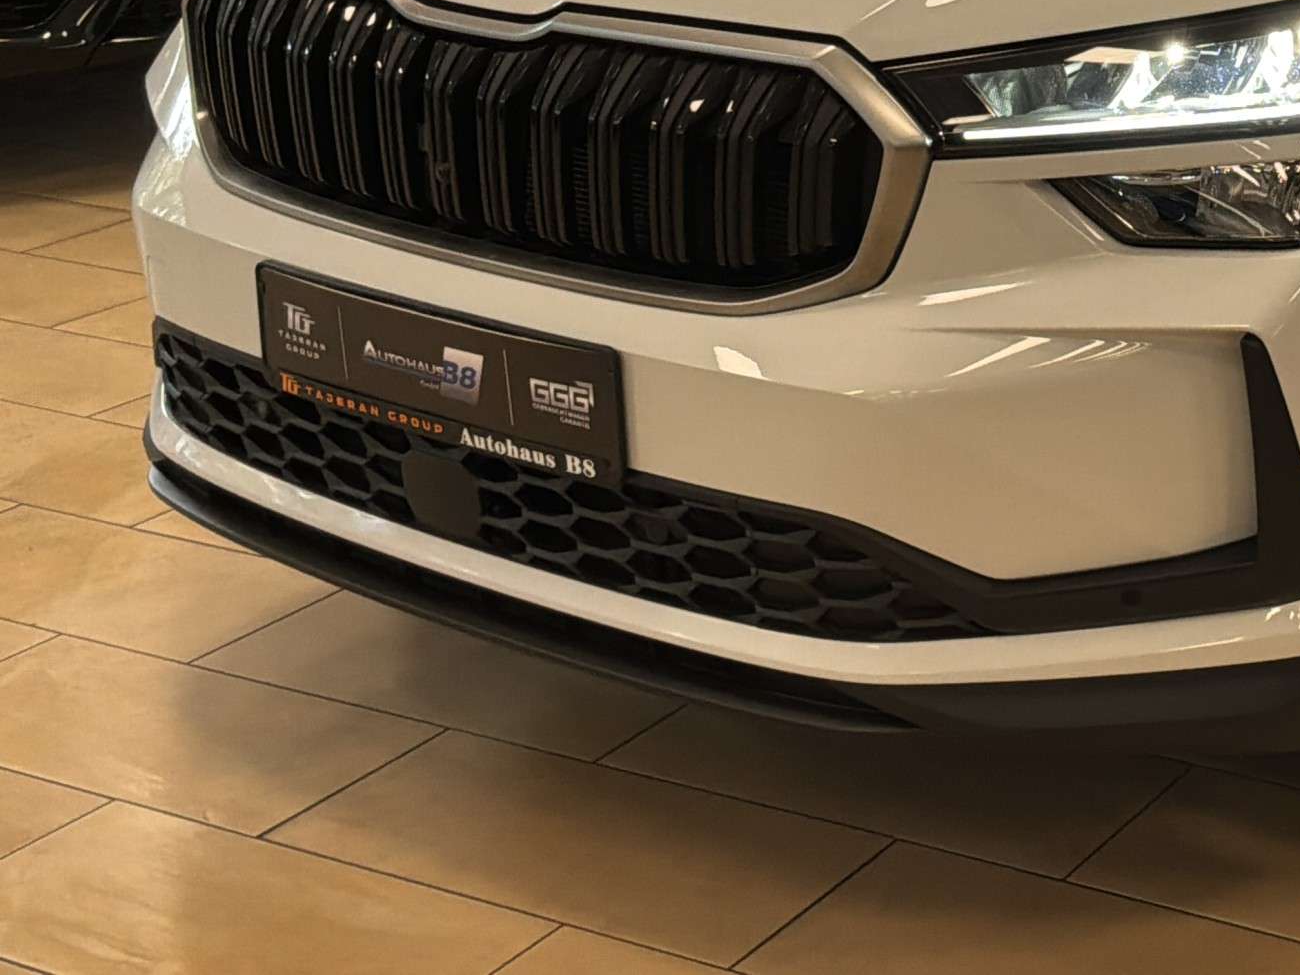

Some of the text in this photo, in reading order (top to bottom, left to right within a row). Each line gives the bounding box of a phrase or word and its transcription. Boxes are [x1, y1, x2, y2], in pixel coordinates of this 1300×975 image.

[286, 343, 320, 359] GROUP
[364, 339, 477, 389] AUTOHAUS B8
[529, 377, 594, 414] GGG
[388, 410, 444, 434] GROUP
[460, 427, 597, 478] Autohaus B8
